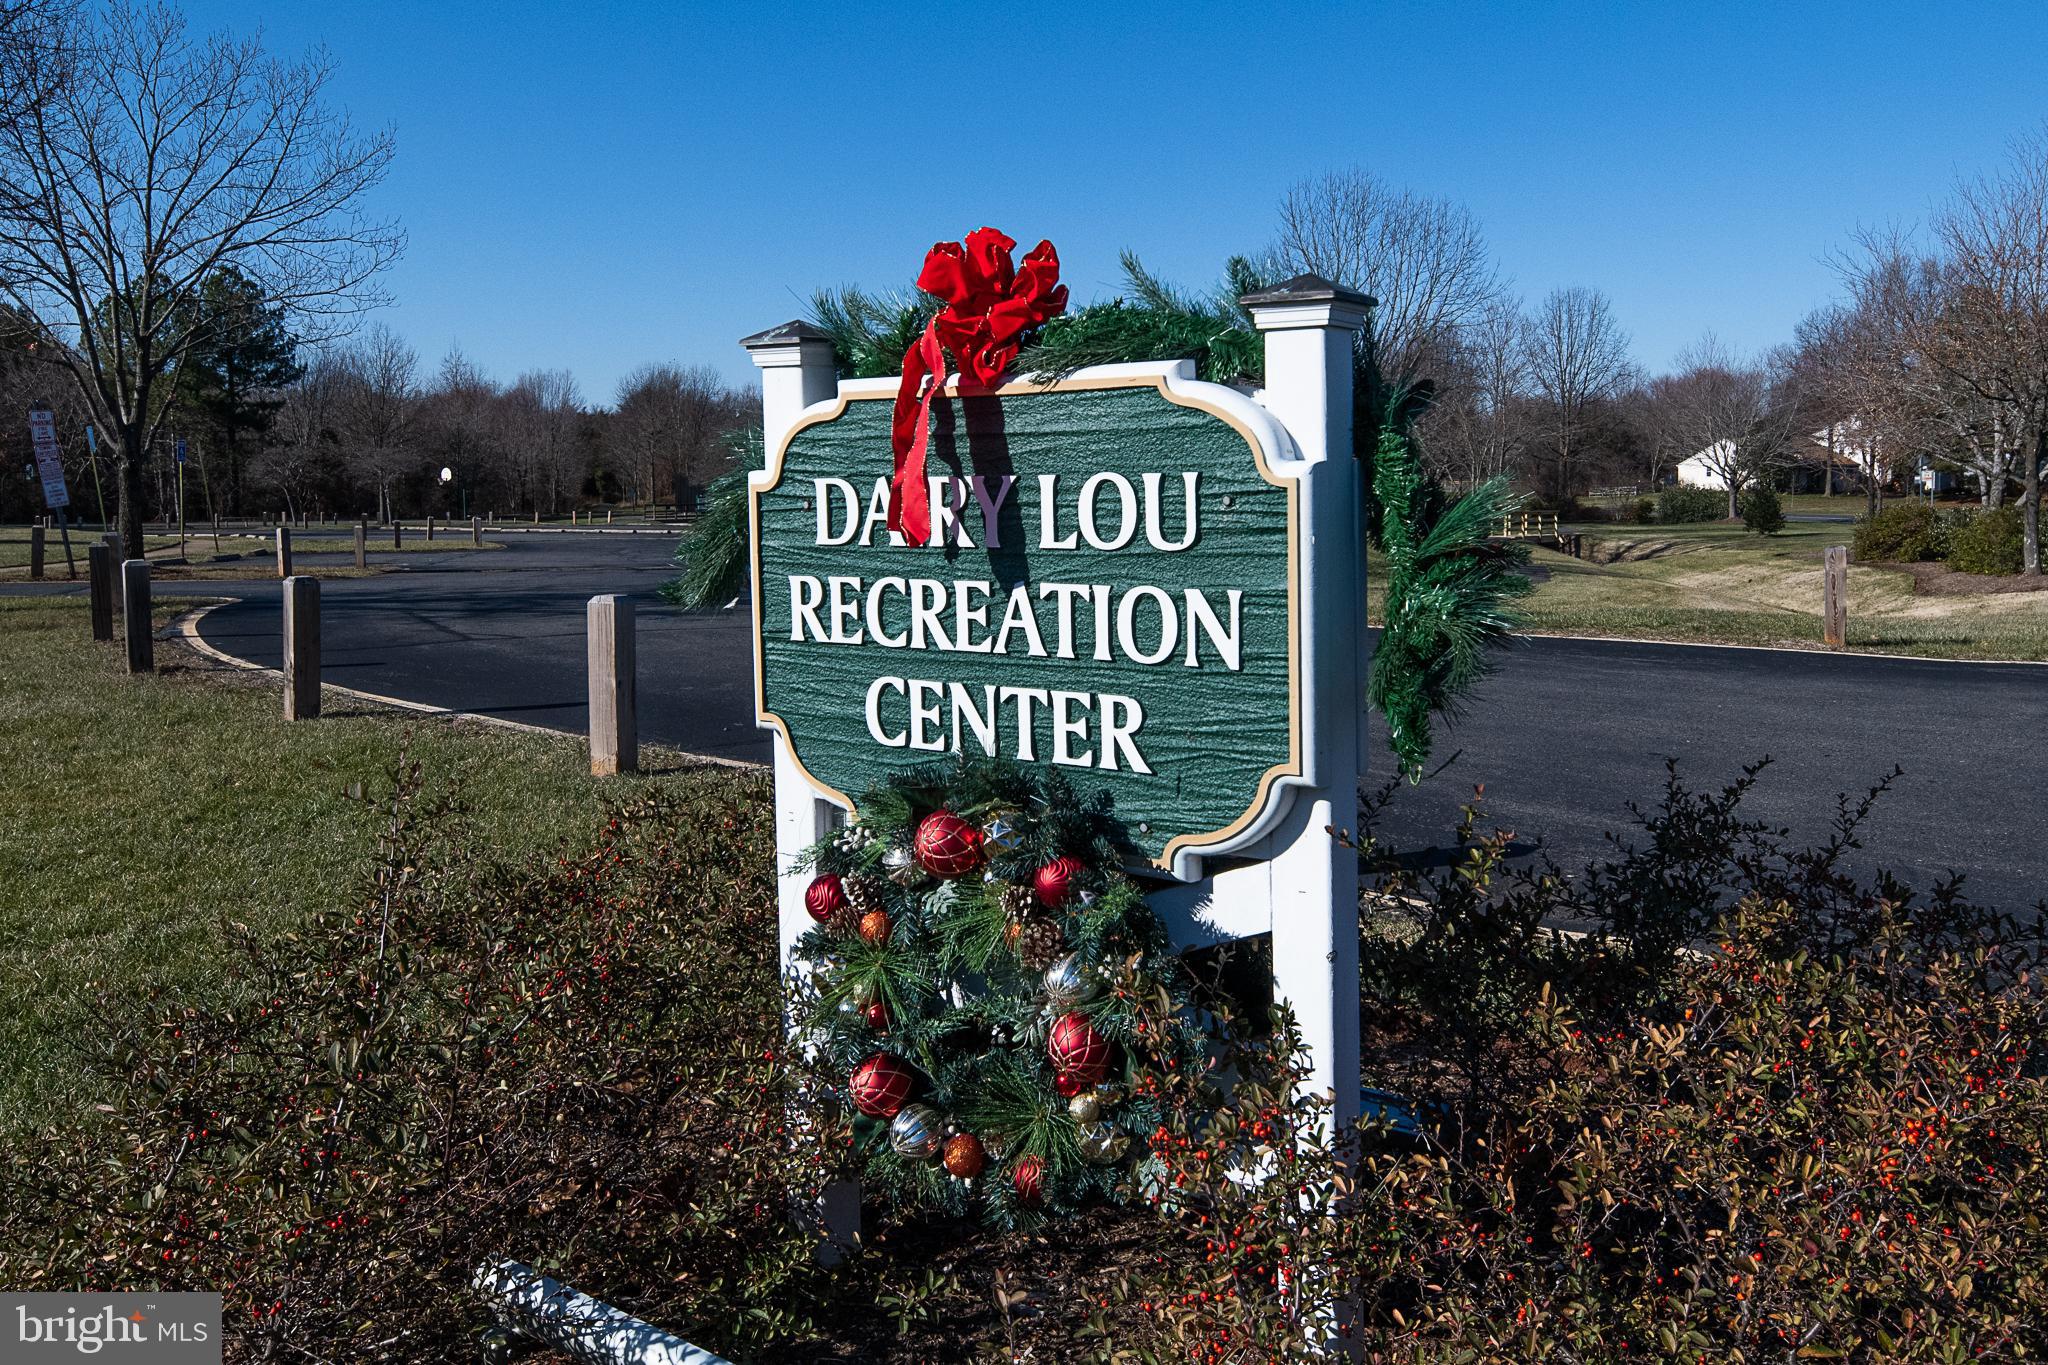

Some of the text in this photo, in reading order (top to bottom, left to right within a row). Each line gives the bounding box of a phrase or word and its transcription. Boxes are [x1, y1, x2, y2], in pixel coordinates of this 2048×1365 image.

[36, 412, 47, 420] NO
[813, 471, 1199, 552] DARY LOU
[788, 575, 1243, 671] RECREATION
[865, 676, 1154, 775] CENTER
